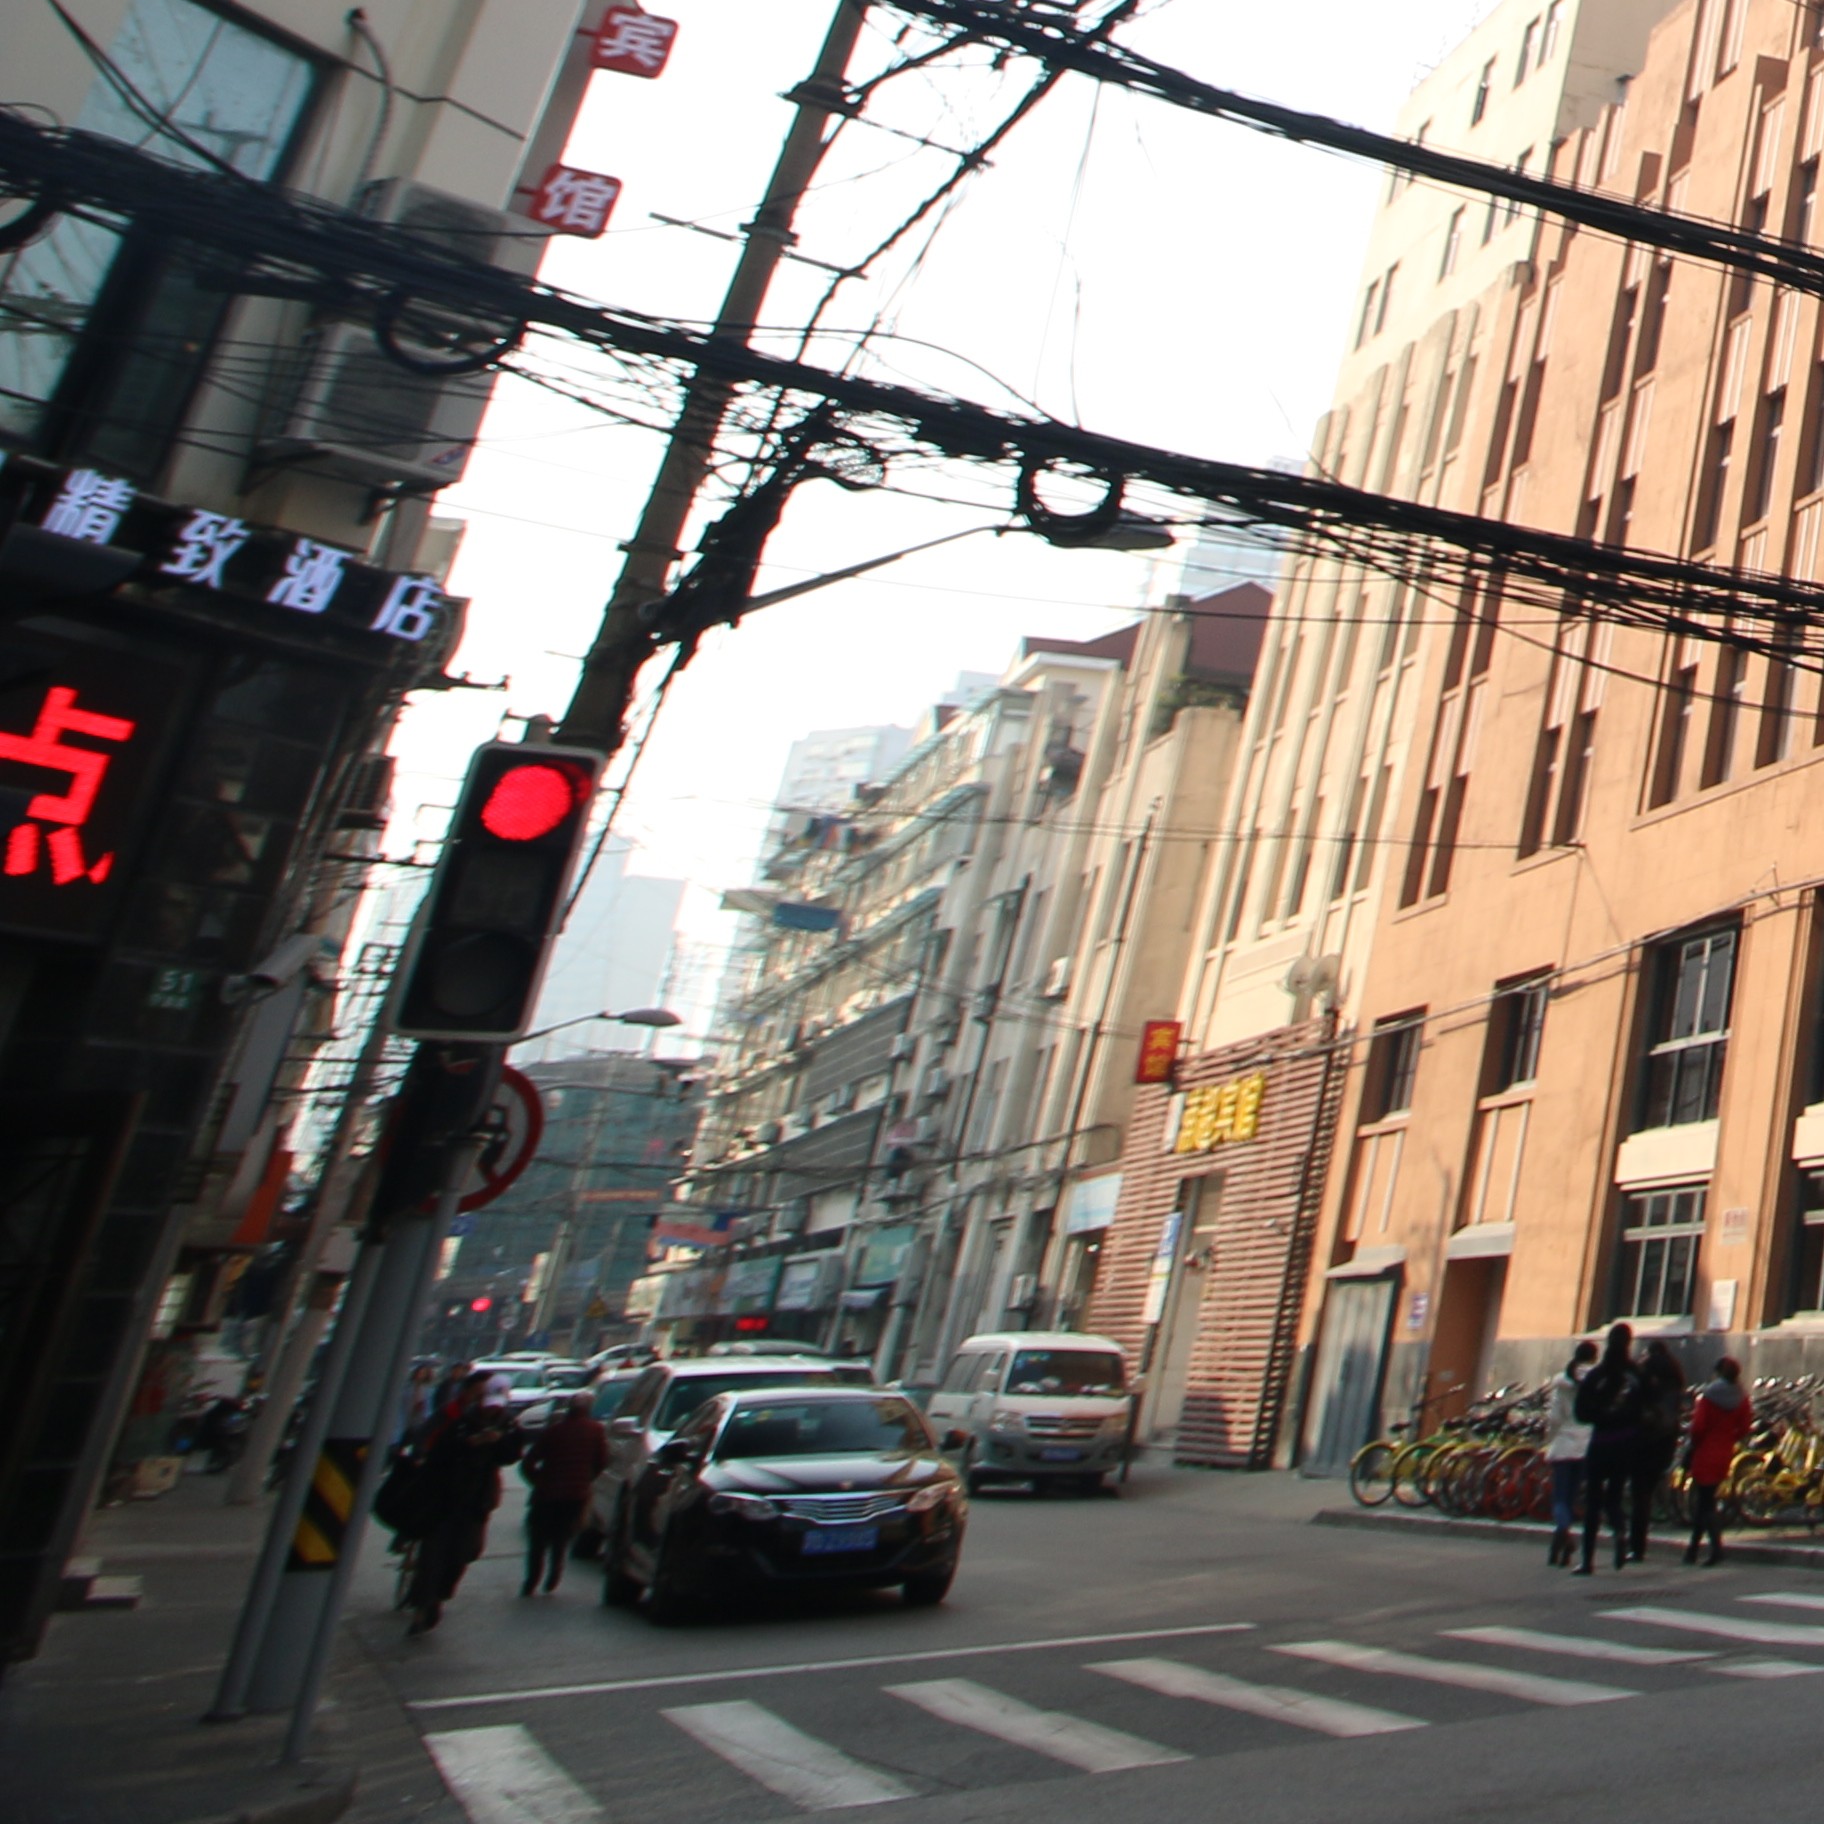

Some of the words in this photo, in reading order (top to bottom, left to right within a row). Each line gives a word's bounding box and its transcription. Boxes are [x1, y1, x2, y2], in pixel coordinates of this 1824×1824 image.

[41, 467, 444, 642] 精致酒店
[0, 685, 135, 885] 点
